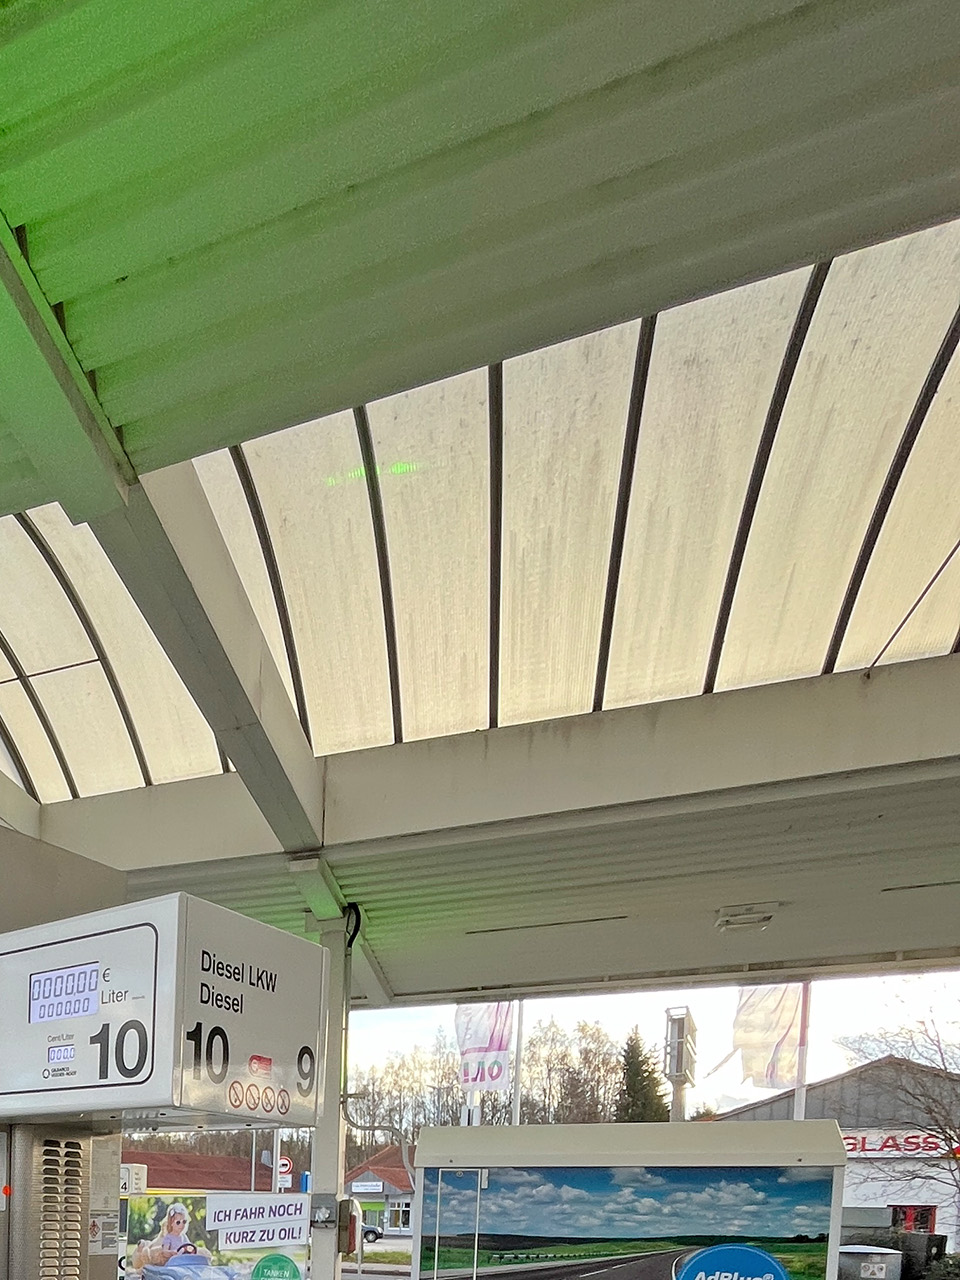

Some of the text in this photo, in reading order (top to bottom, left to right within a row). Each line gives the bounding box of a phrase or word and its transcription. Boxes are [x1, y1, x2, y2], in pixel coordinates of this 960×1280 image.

[102, 967, 111, 983] €
[201, 950, 277, 992] Diesel LKW
[101, 989, 129, 1005] Liter
[200, 982, 244, 1014] Diesel
[89, 1018, 149, 1080] 10
[186, 1021, 229, 1085] 10
[296, 1045, 315, 1098] 9
[121, 1182, 127, 1191] 4
[213, 1202, 303, 1223] ICH FAHR NOCH
[225, 1226, 302, 1245] KURZ ZU OIL!
[263, 1269, 290, 1278] TANKEN
